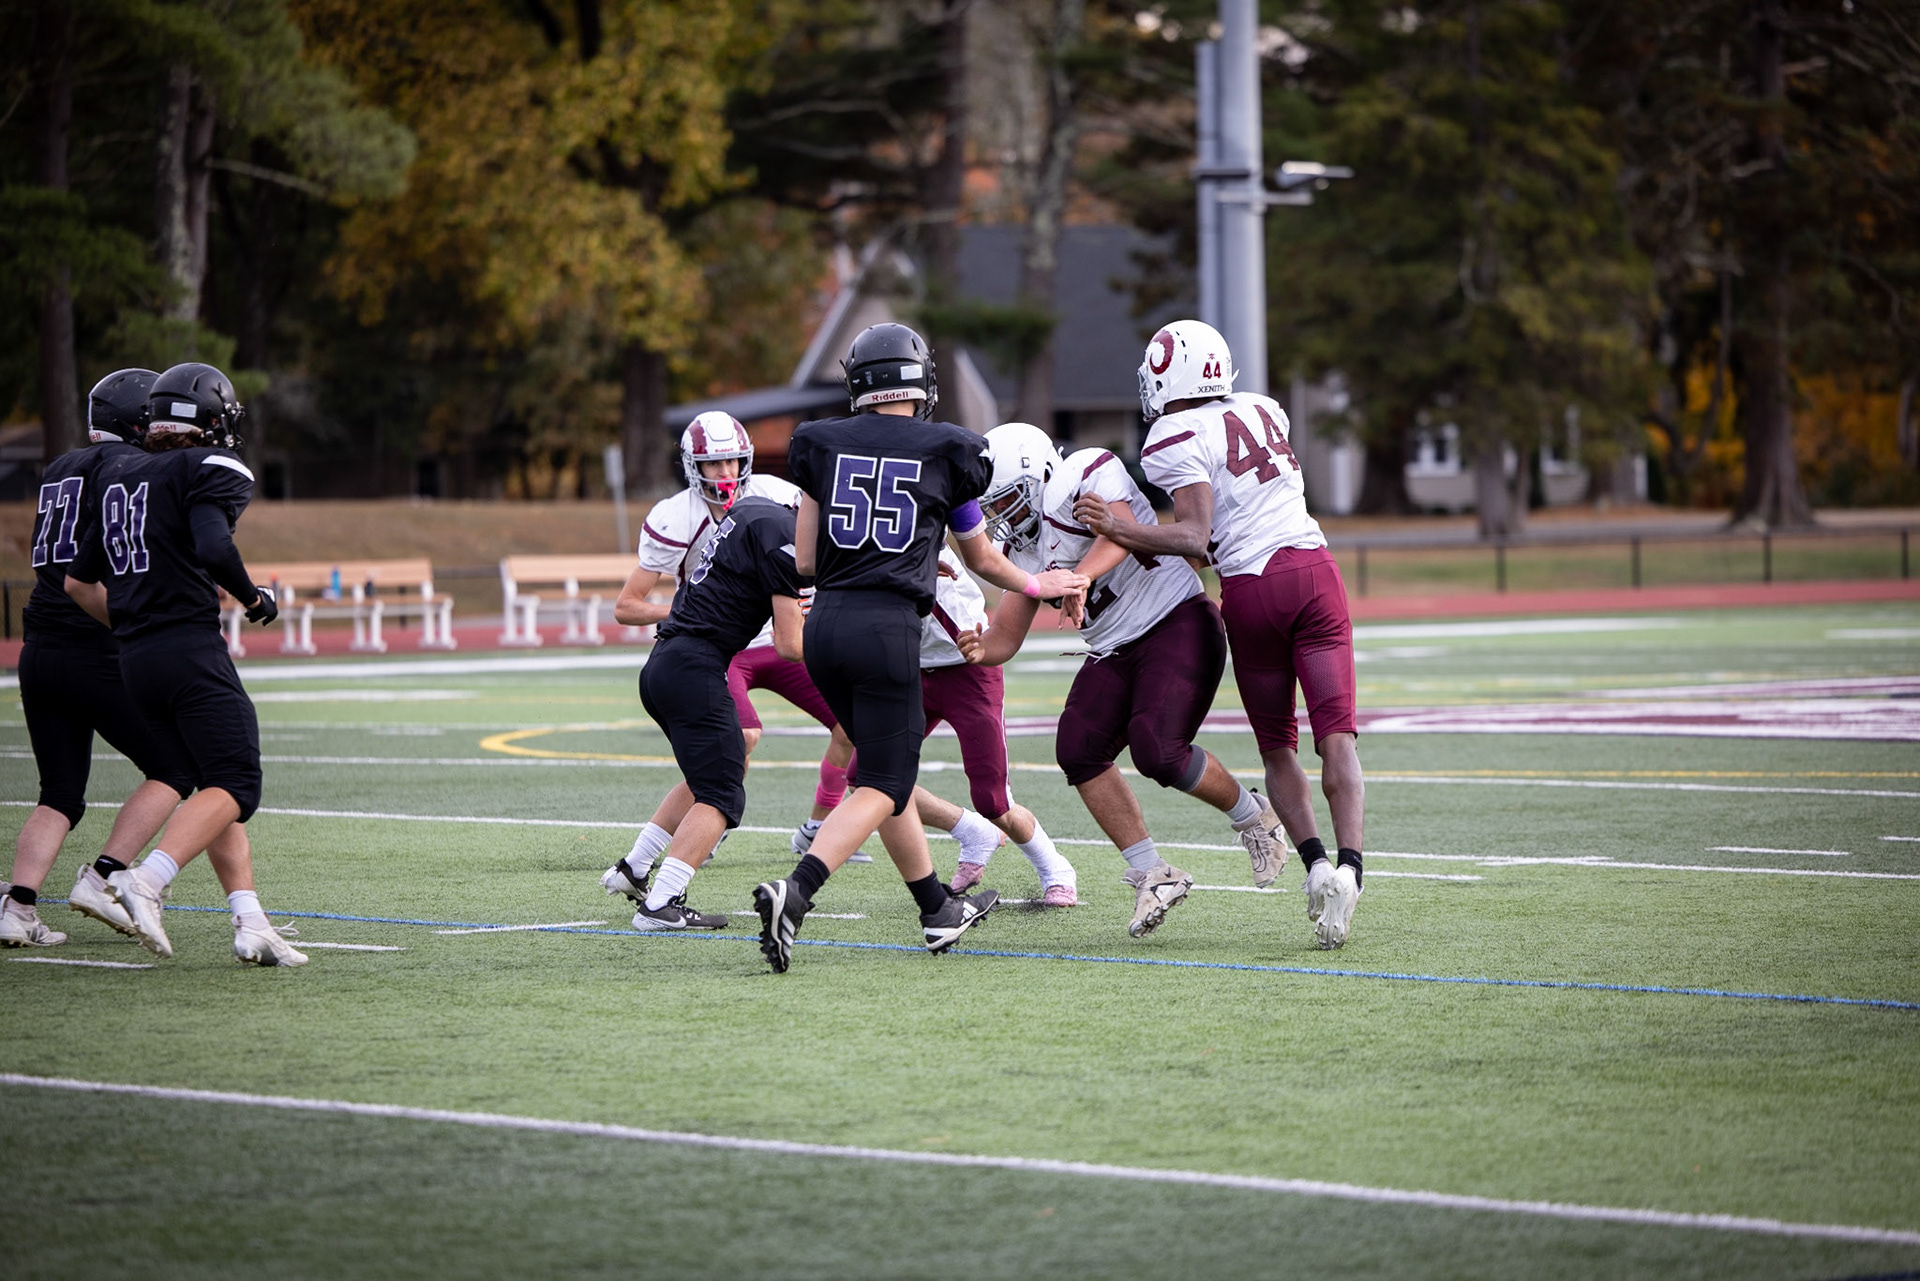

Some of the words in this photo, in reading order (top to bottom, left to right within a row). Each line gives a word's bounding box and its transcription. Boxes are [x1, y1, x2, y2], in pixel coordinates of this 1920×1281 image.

[871, 390, 909, 403] Riddell
[1197, 384, 1226, 394] XENITH
[1202, 360, 1222, 380] 44
[1222, 404, 1300, 485] 44
[32, 476, 84, 568] 77
[102, 481, 150, 576] 81
[828, 453, 922, 554] 55
